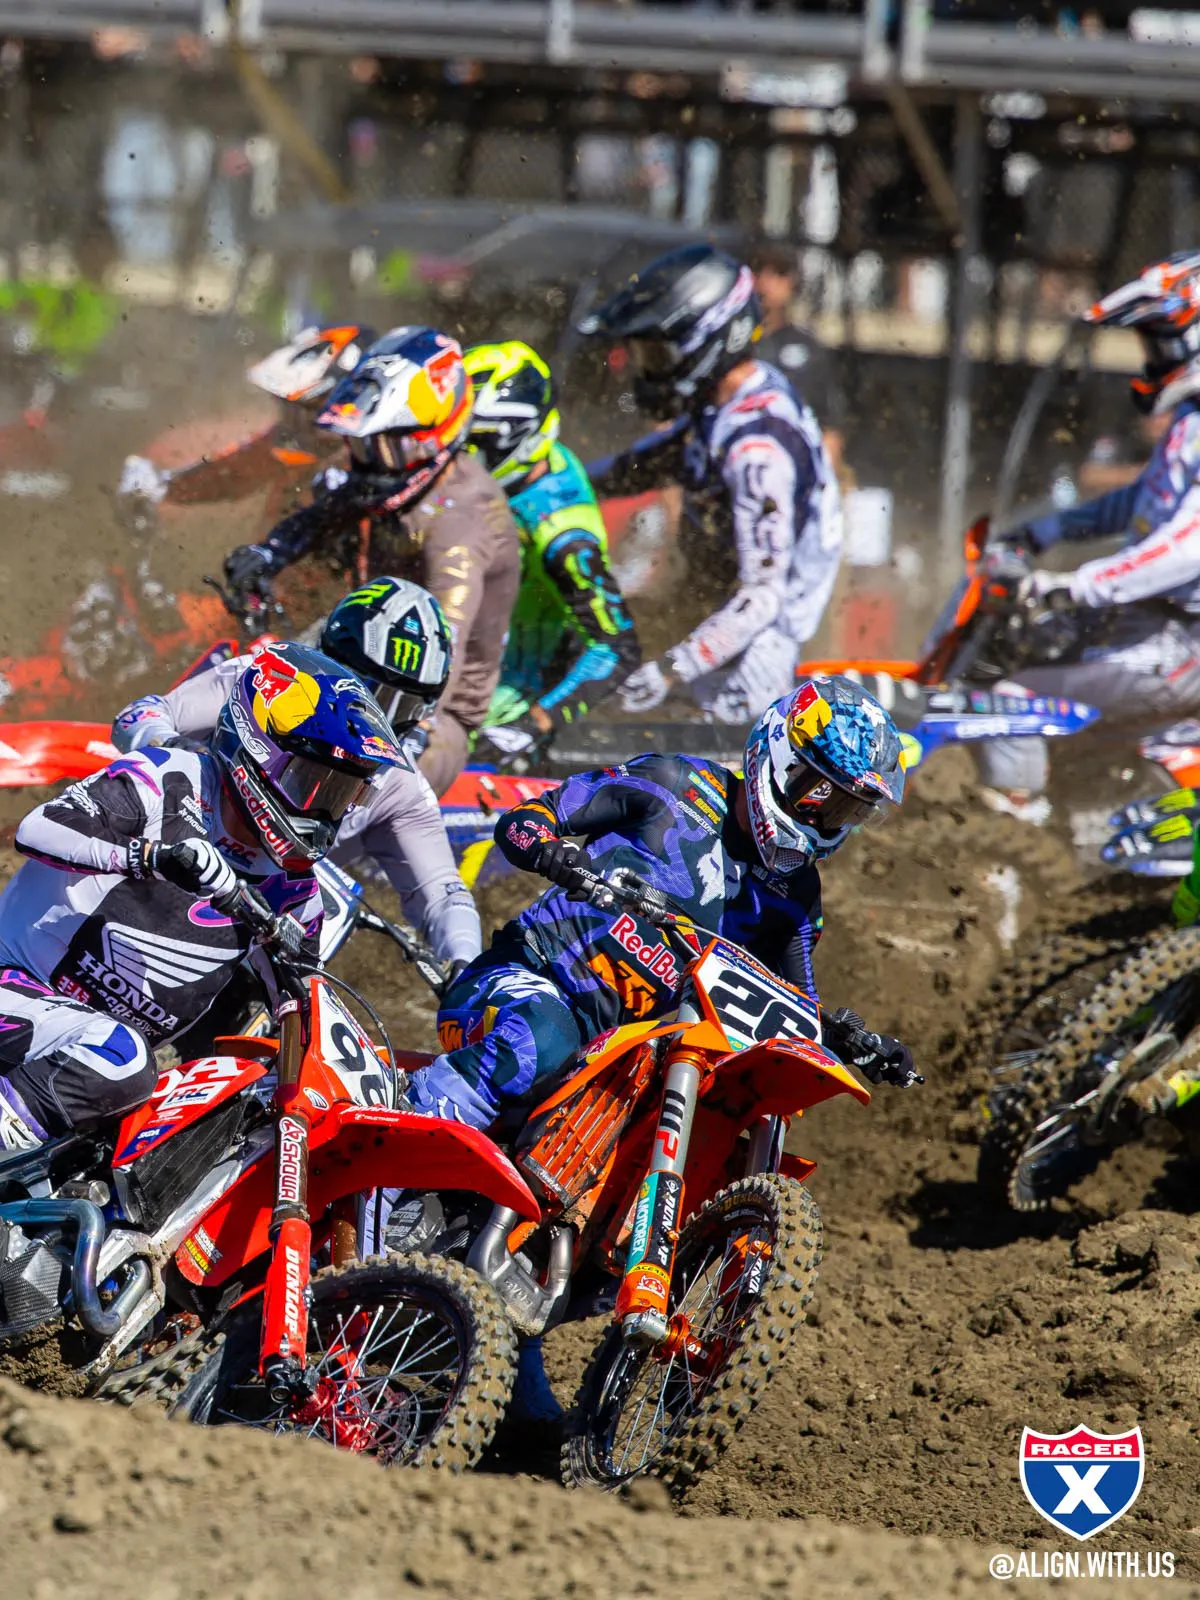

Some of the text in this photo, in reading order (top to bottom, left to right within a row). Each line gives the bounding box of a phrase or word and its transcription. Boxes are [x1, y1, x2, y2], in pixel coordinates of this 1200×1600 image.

[77, 950, 179, 1031] HONDA
[279, 1142, 300, 1202] SHOWA
[632, 1196, 651, 1259] MOTOREX
[285, 1246, 301, 1334] DUNLOP
